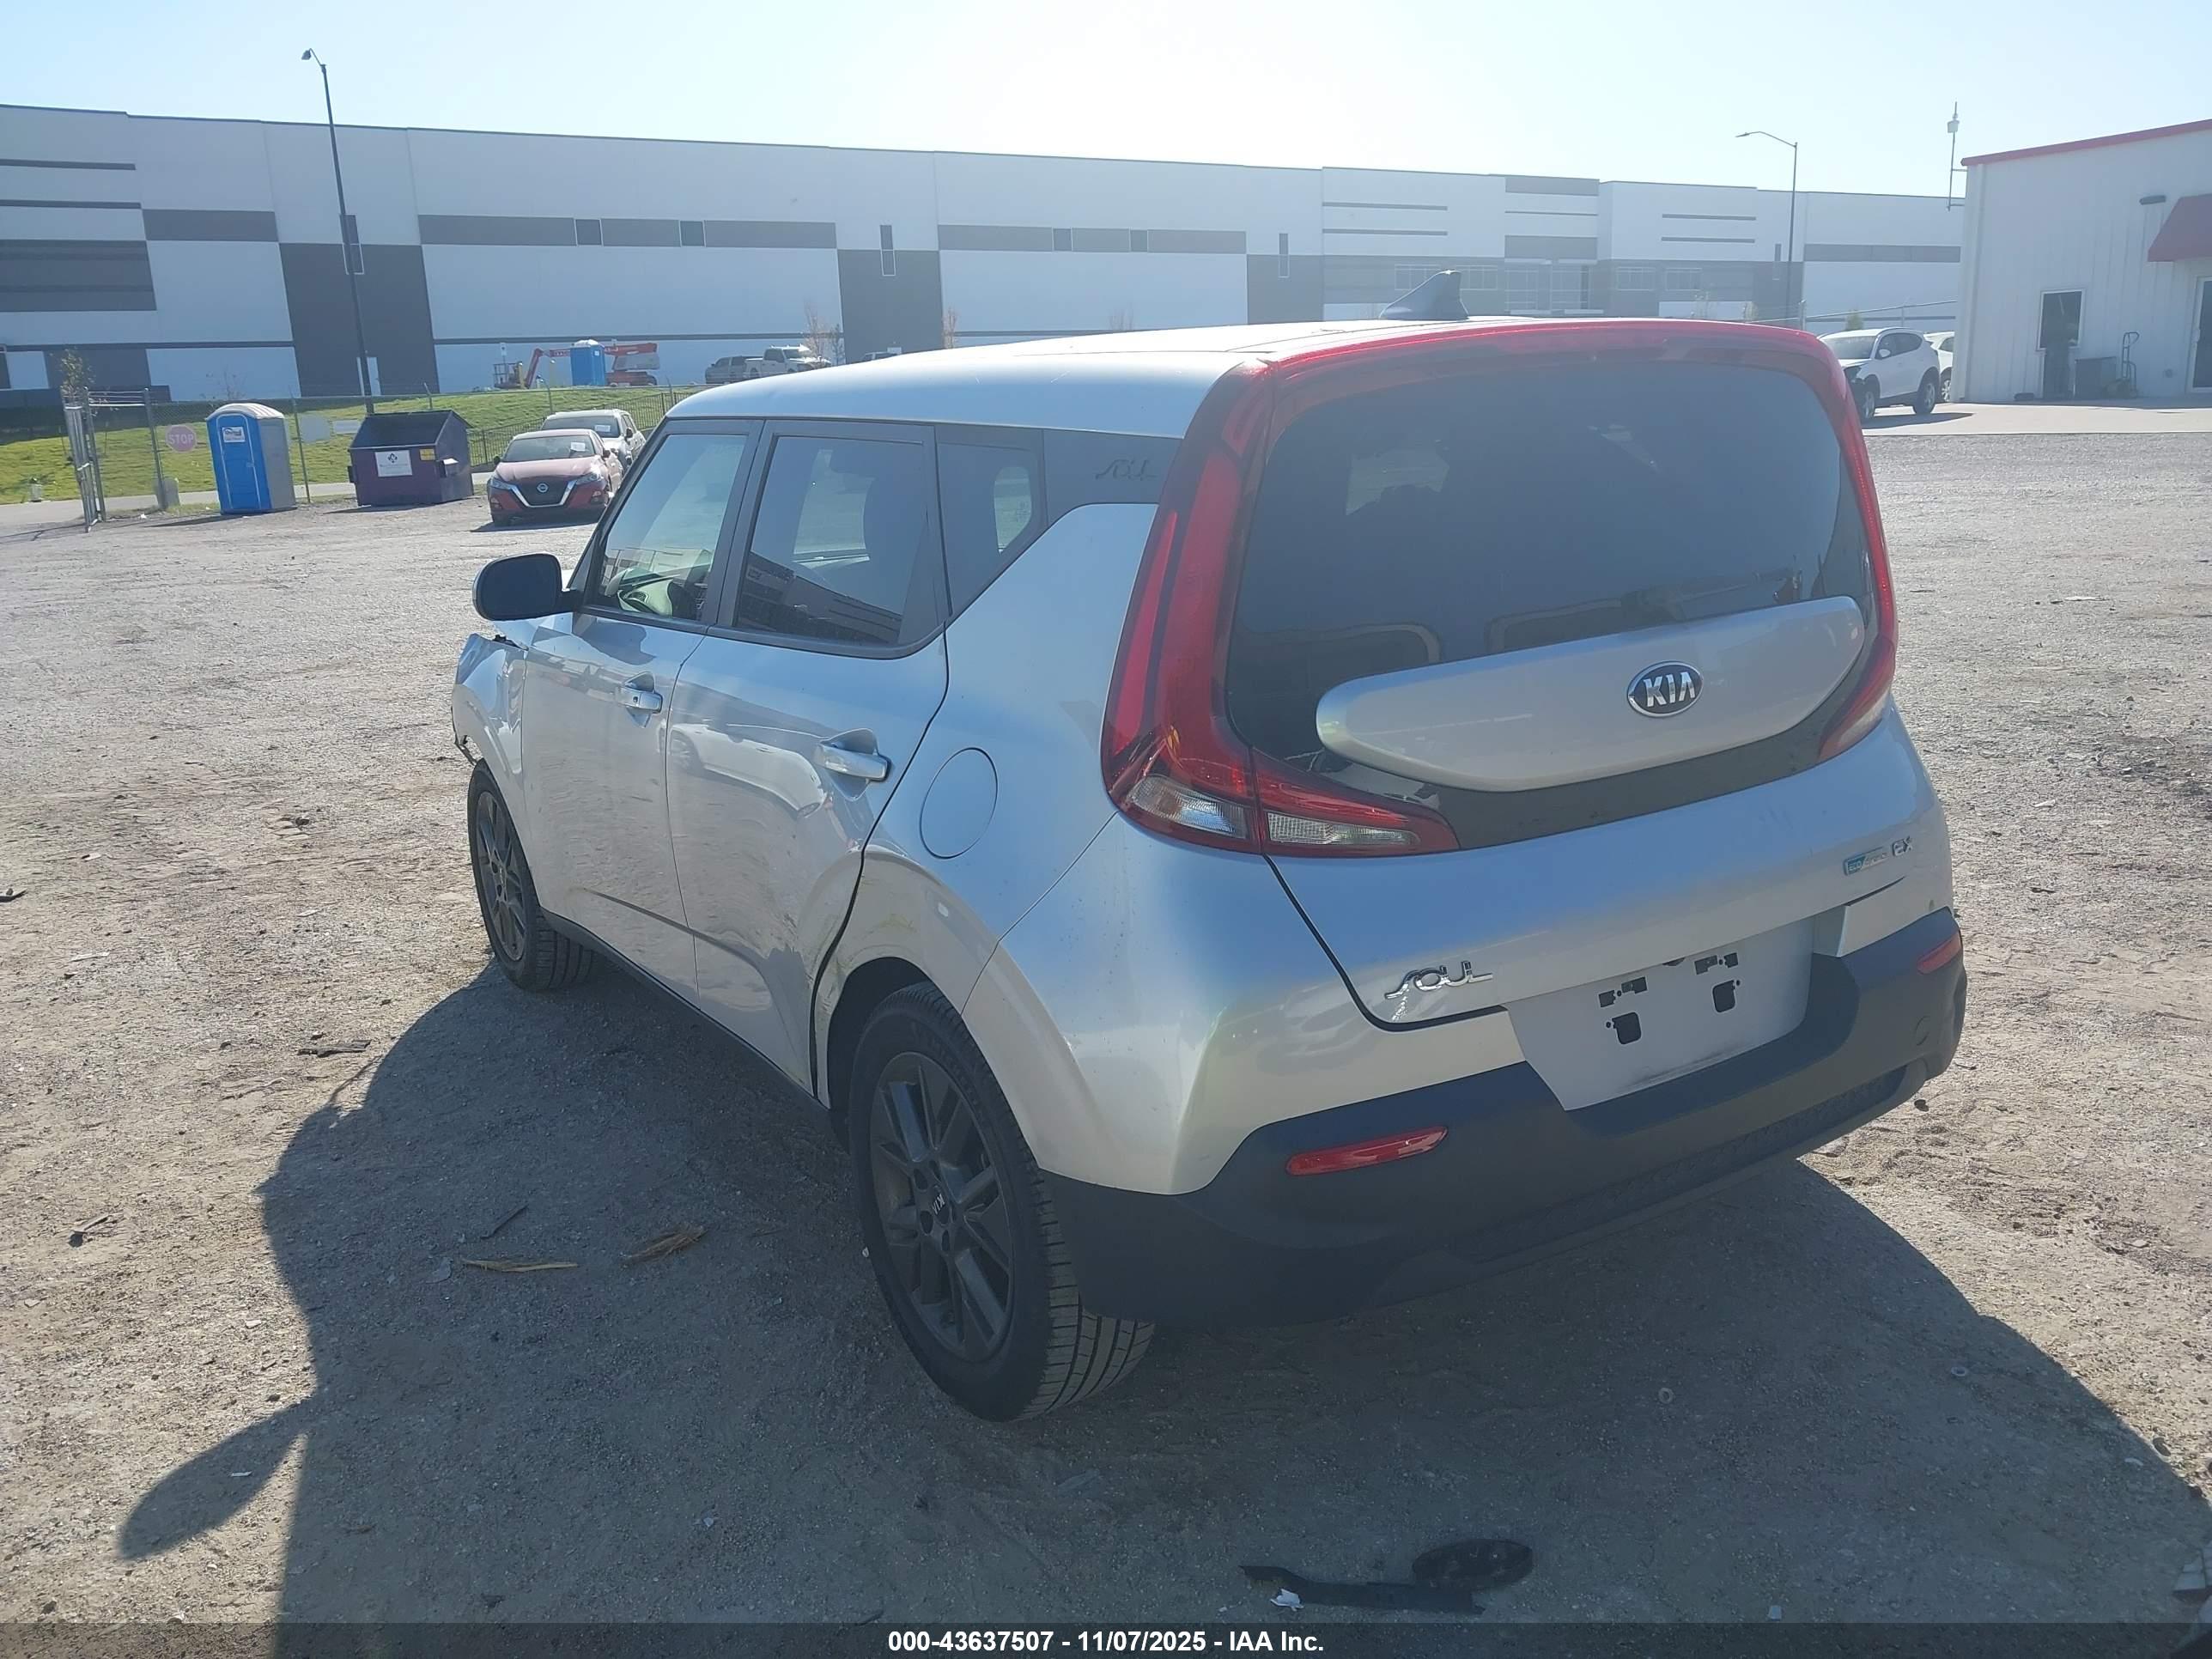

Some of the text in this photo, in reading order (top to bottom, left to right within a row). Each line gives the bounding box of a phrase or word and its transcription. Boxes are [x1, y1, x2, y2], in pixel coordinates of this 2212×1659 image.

[168, 434, 194, 444] STOP
[1643, 672, 1696, 708] KIA
[1892, 836, 1913, 857] EX
[1384, 960, 1494, 1000] SOUL
